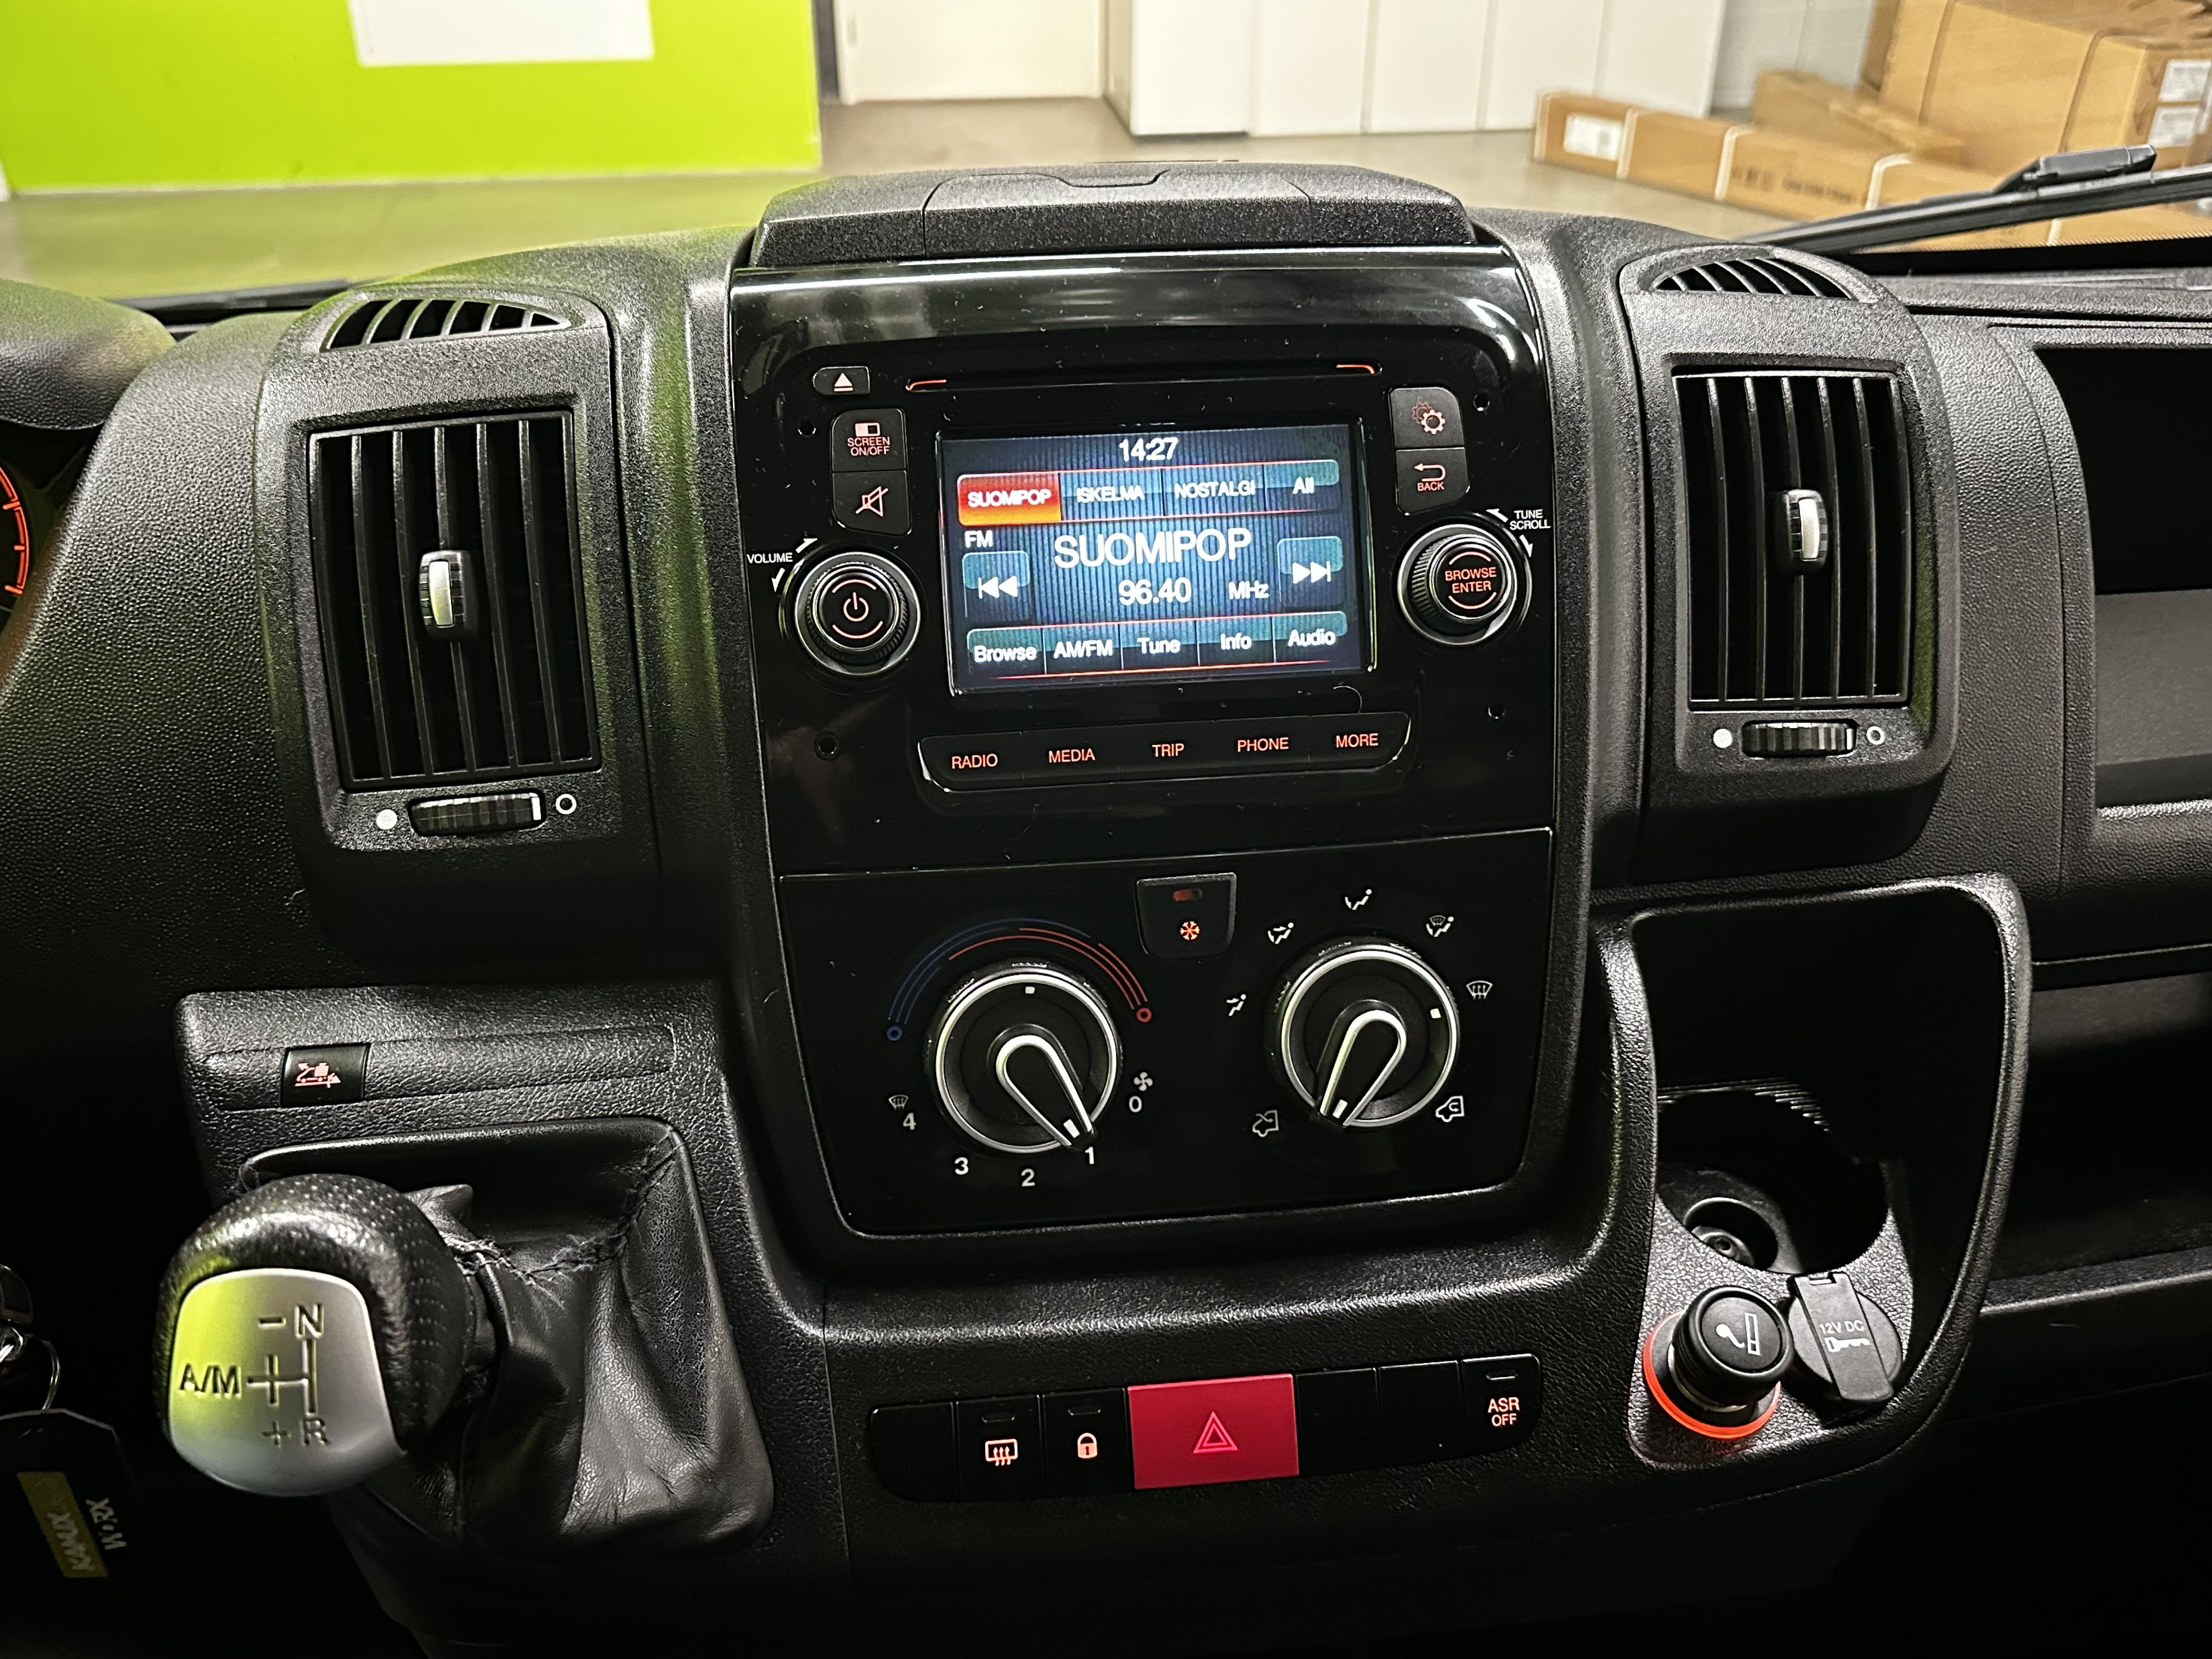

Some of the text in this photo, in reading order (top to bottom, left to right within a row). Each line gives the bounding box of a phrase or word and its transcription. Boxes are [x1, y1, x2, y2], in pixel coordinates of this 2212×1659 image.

[847, 437, 890, 447] SCREEN
[1119, 437, 1178, 462] 14:27
[850, 446, 890, 457] ON/OFF
[1174, 479, 1256, 499] NOSTALGI
[1292, 477, 1315, 495] All
[1417, 481, 1445, 492] BACK
[967, 488, 1052, 508] SUOMIPOP
[1514, 509, 1543, 520] TUNE
[1509, 518, 1551, 531] SCROLL
[964, 529, 994, 549] FM
[1054, 527, 1252, 569] SUOMIPOP
[747, 551, 793, 565] VOLUME
[1444, 566, 1497, 582] BROWSE
[1118, 577, 1269, 606] 96.40 MHz
[1452, 579, 1492, 594] ENTER
[1136, 636, 1181, 654] Tune
[1220, 631, 1252, 651] Info
[1288, 628, 1336, 647] Audio
[973, 644, 1037, 663] Browse
[1053, 639, 1113, 659] AM/FM
[1236, 737, 1290, 753] PHONE
[1335, 732, 1379, 748] MORE
[1048, 748, 1096, 764] MEDIA
[1152, 743, 1186, 758] TRIP
[951, 753, 998, 770] RADIO
[1128, 1096, 1142, 1113] 0
[901, 1112, 917, 1131] 4
[1084, 1146, 1096, 1165] 1
[953, 1157, 970, 1175] 3
[1020, 1168, 1036, 1187] 2
[295, 1304, 324, 1339] N
[1819, 1319, 1865, 1335] 12V DC
[179, 1363, 241, 1397] A/M
[1487, 1397, 1521, 1413] ASR
[1491, 1413, 1517, 1427] OFF
[301, 1417, 329, 1447] R
